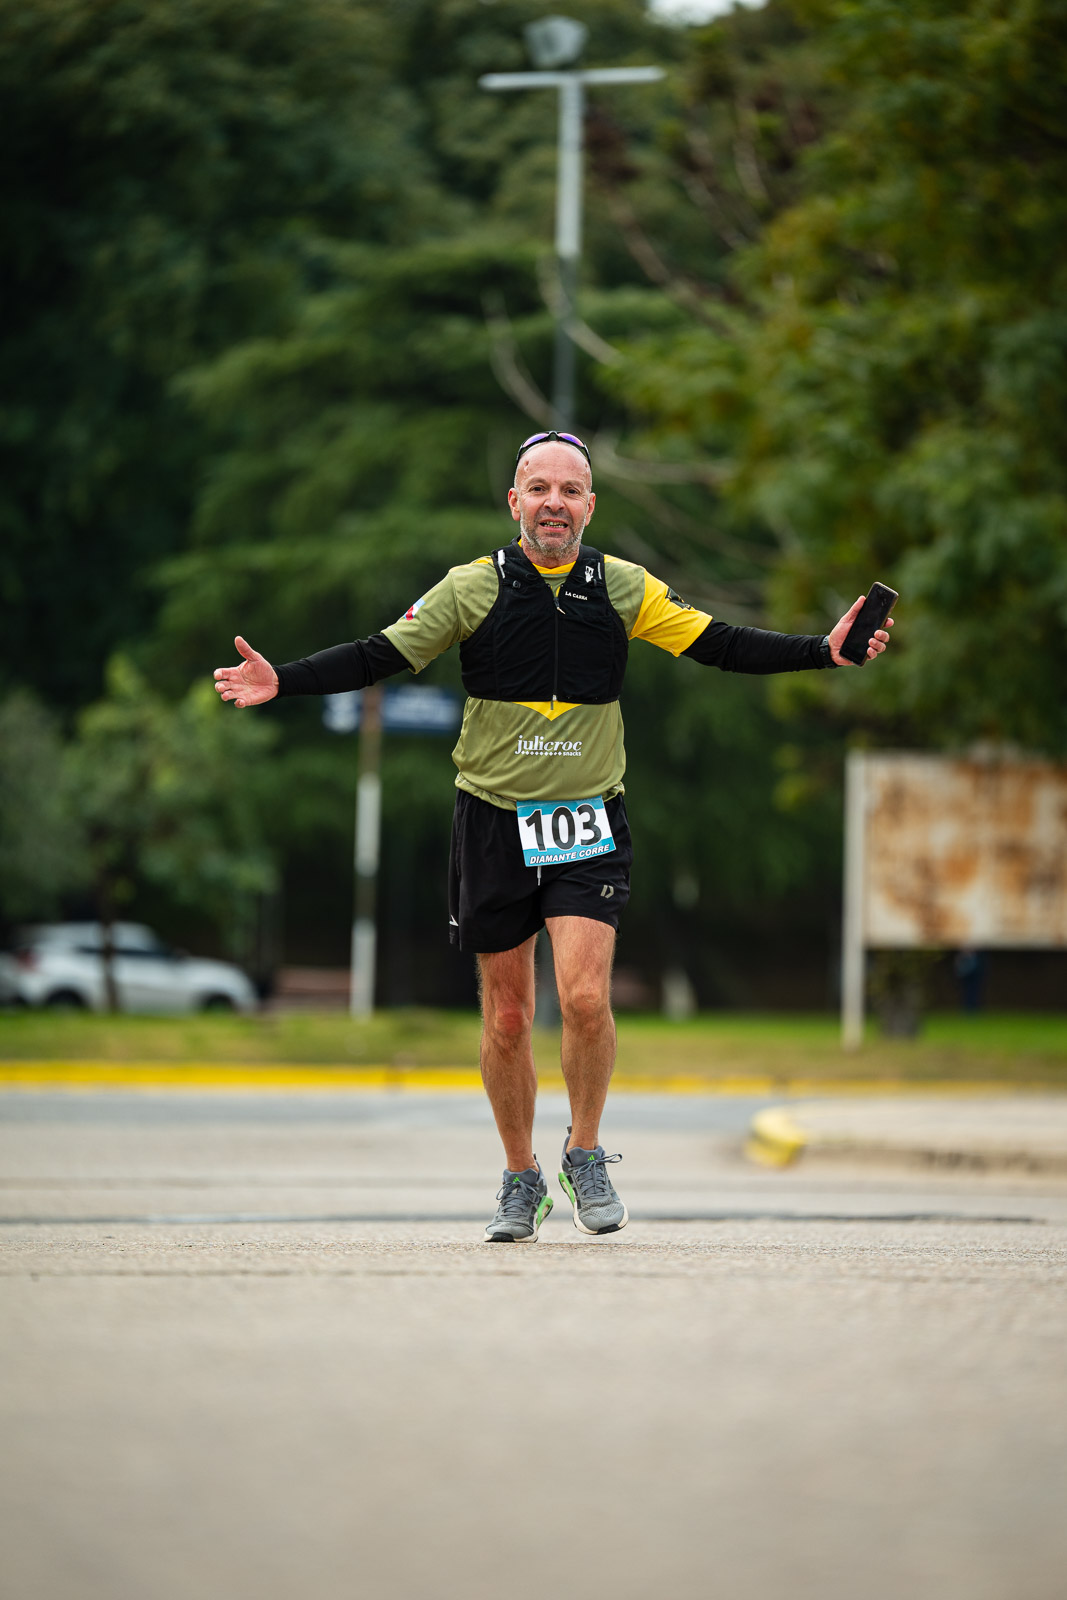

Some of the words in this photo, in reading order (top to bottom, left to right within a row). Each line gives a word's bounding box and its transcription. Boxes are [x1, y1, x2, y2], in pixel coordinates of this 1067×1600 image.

[515, 735, 582, 755] julicroc
[525, 804, 602, 851] 103
[529, 852, 577, 865] DIAMANTE
[579, 844, 610, 857] CORRE
